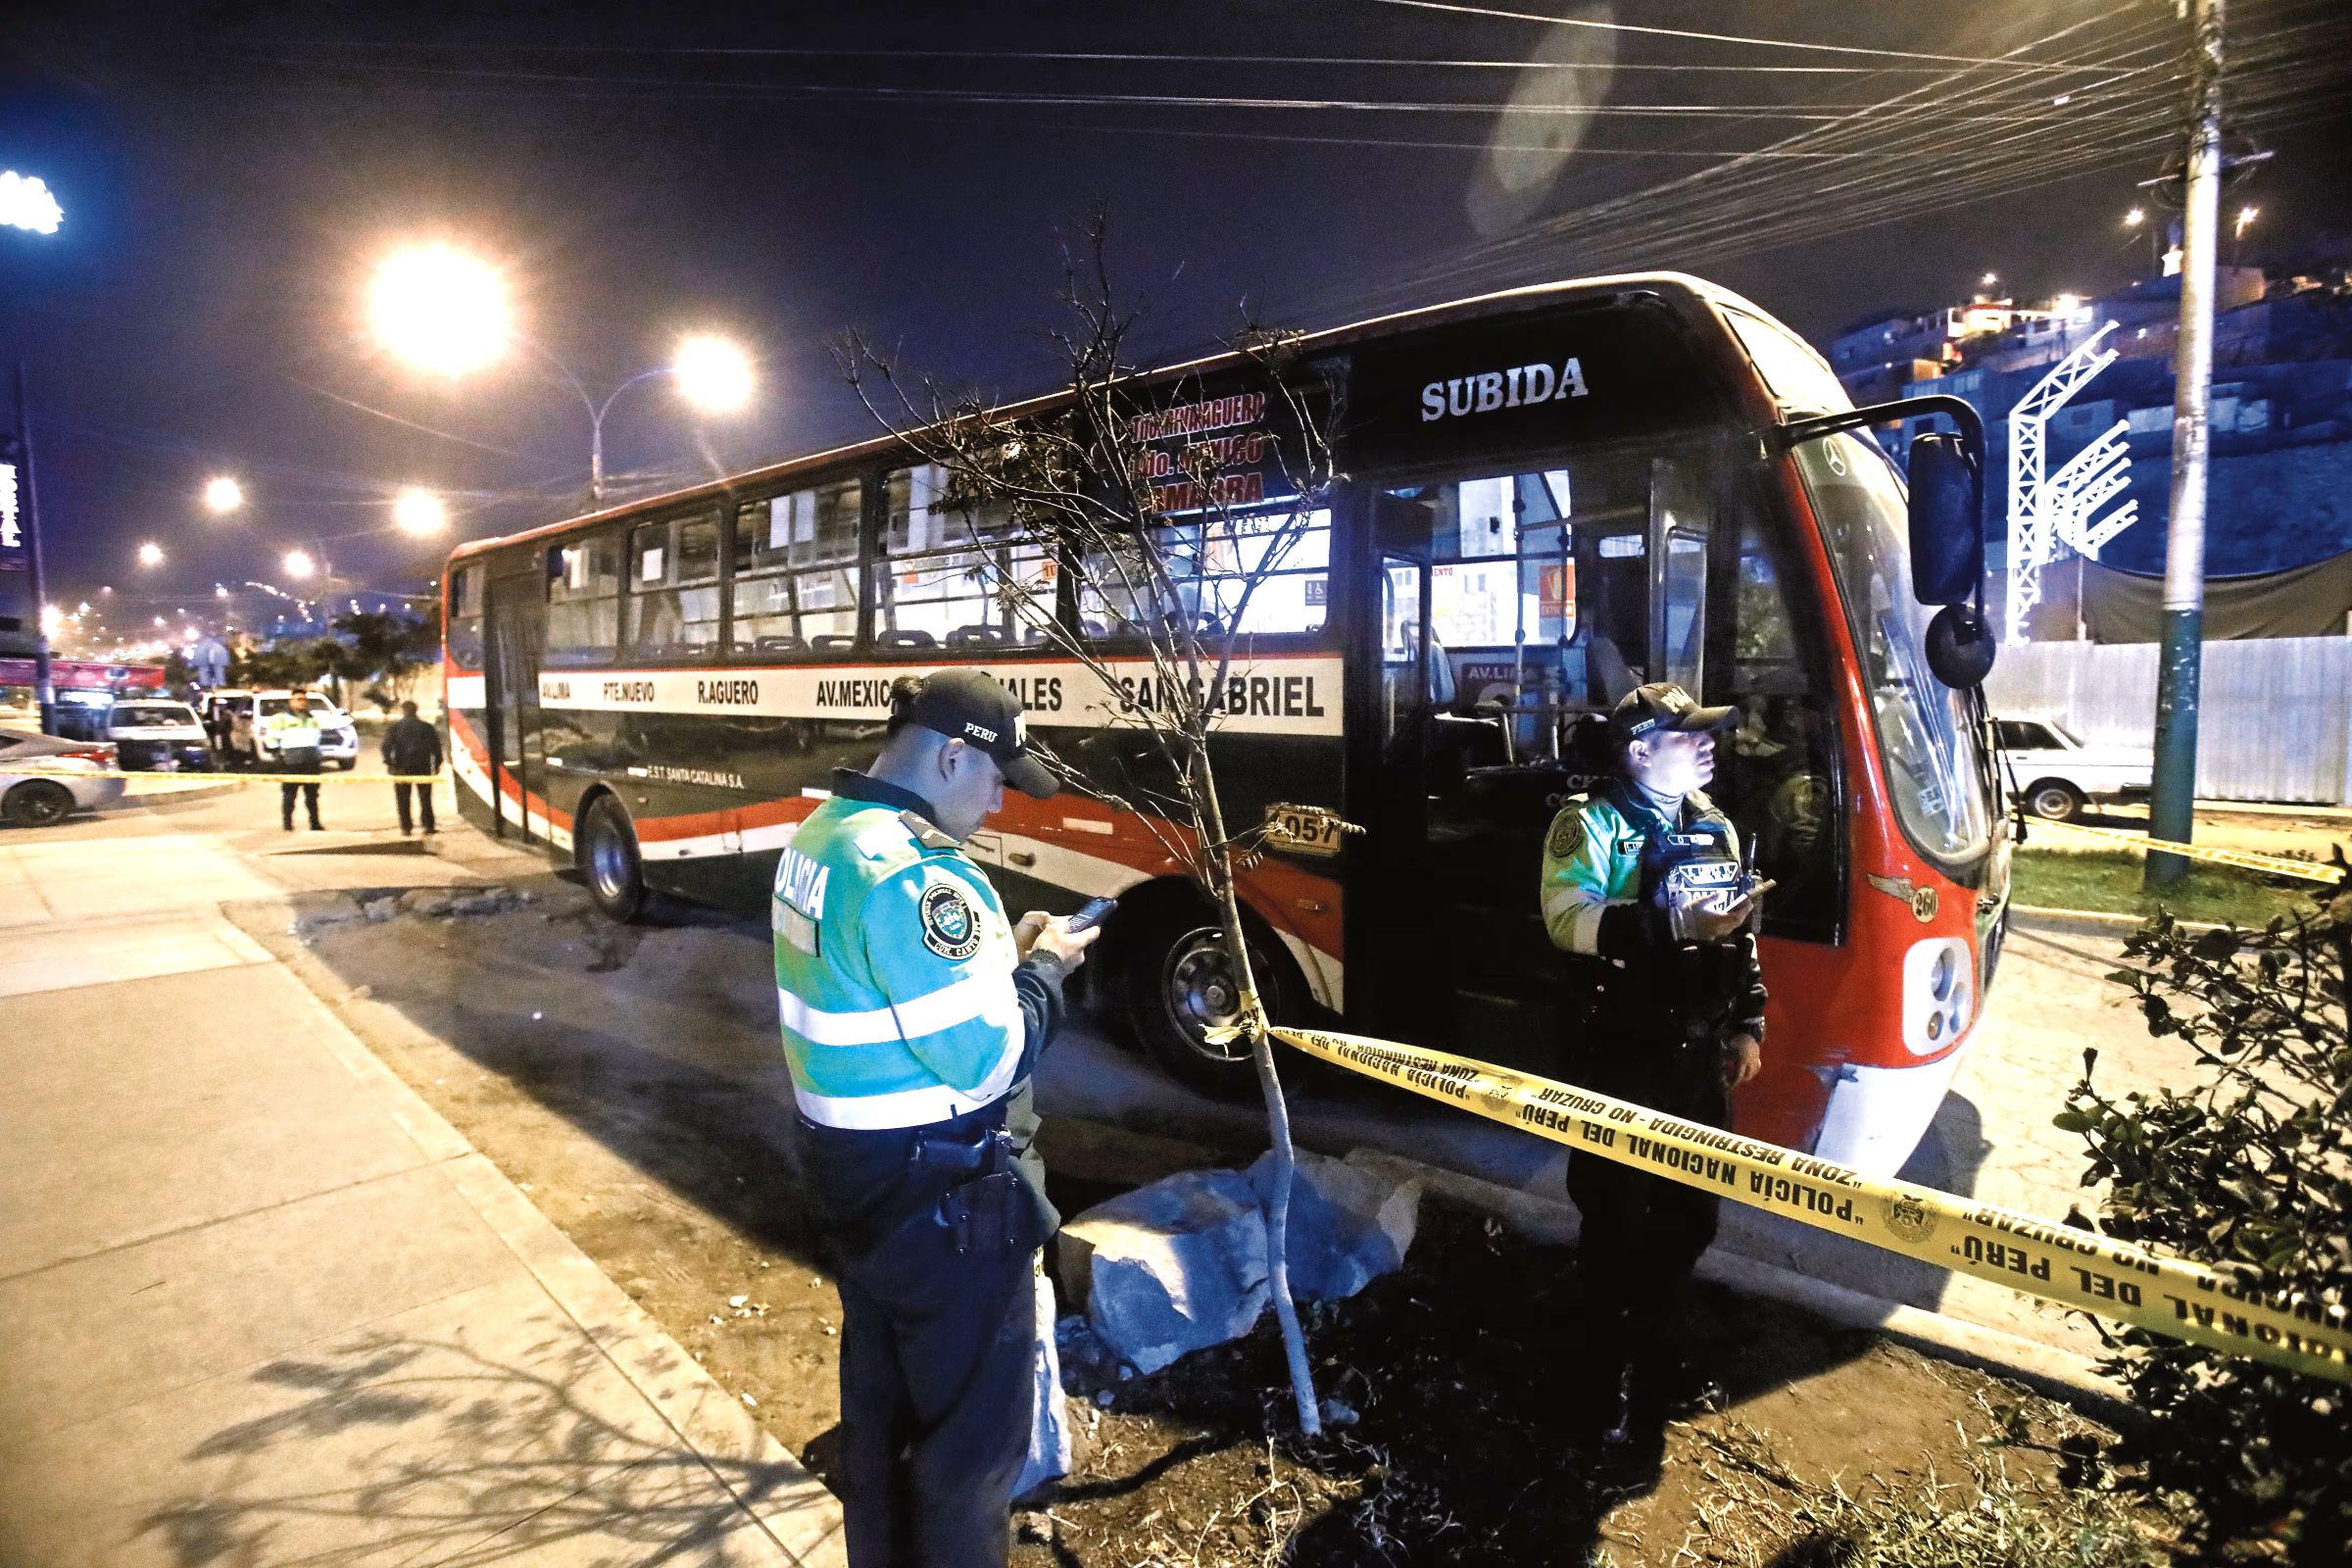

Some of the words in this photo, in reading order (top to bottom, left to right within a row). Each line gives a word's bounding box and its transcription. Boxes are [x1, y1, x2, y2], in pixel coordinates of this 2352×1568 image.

[1422, 357, 1589, 421] SUBIDA
[698, 679, 759, 705] R.AGUERO
[816, 679, 894, 708] AV.MEXIC
[1187, 675, 1325, 717] GABRIEL
[964, 722, 998, 743] PERU
[774, 847, 830, 920] OLICIA
[1916, 890, 1937, 916] 260
[1608, 1107, 1638, 1124] NO
[1581, 1119, 1616, 1148] DEL
[1648, 1117, 1787, 1166] RESTRINGIDA
[1627, 1133, 1737, 1186] NACIONAL
[2070, 1265, 2142, 1306] DEL
